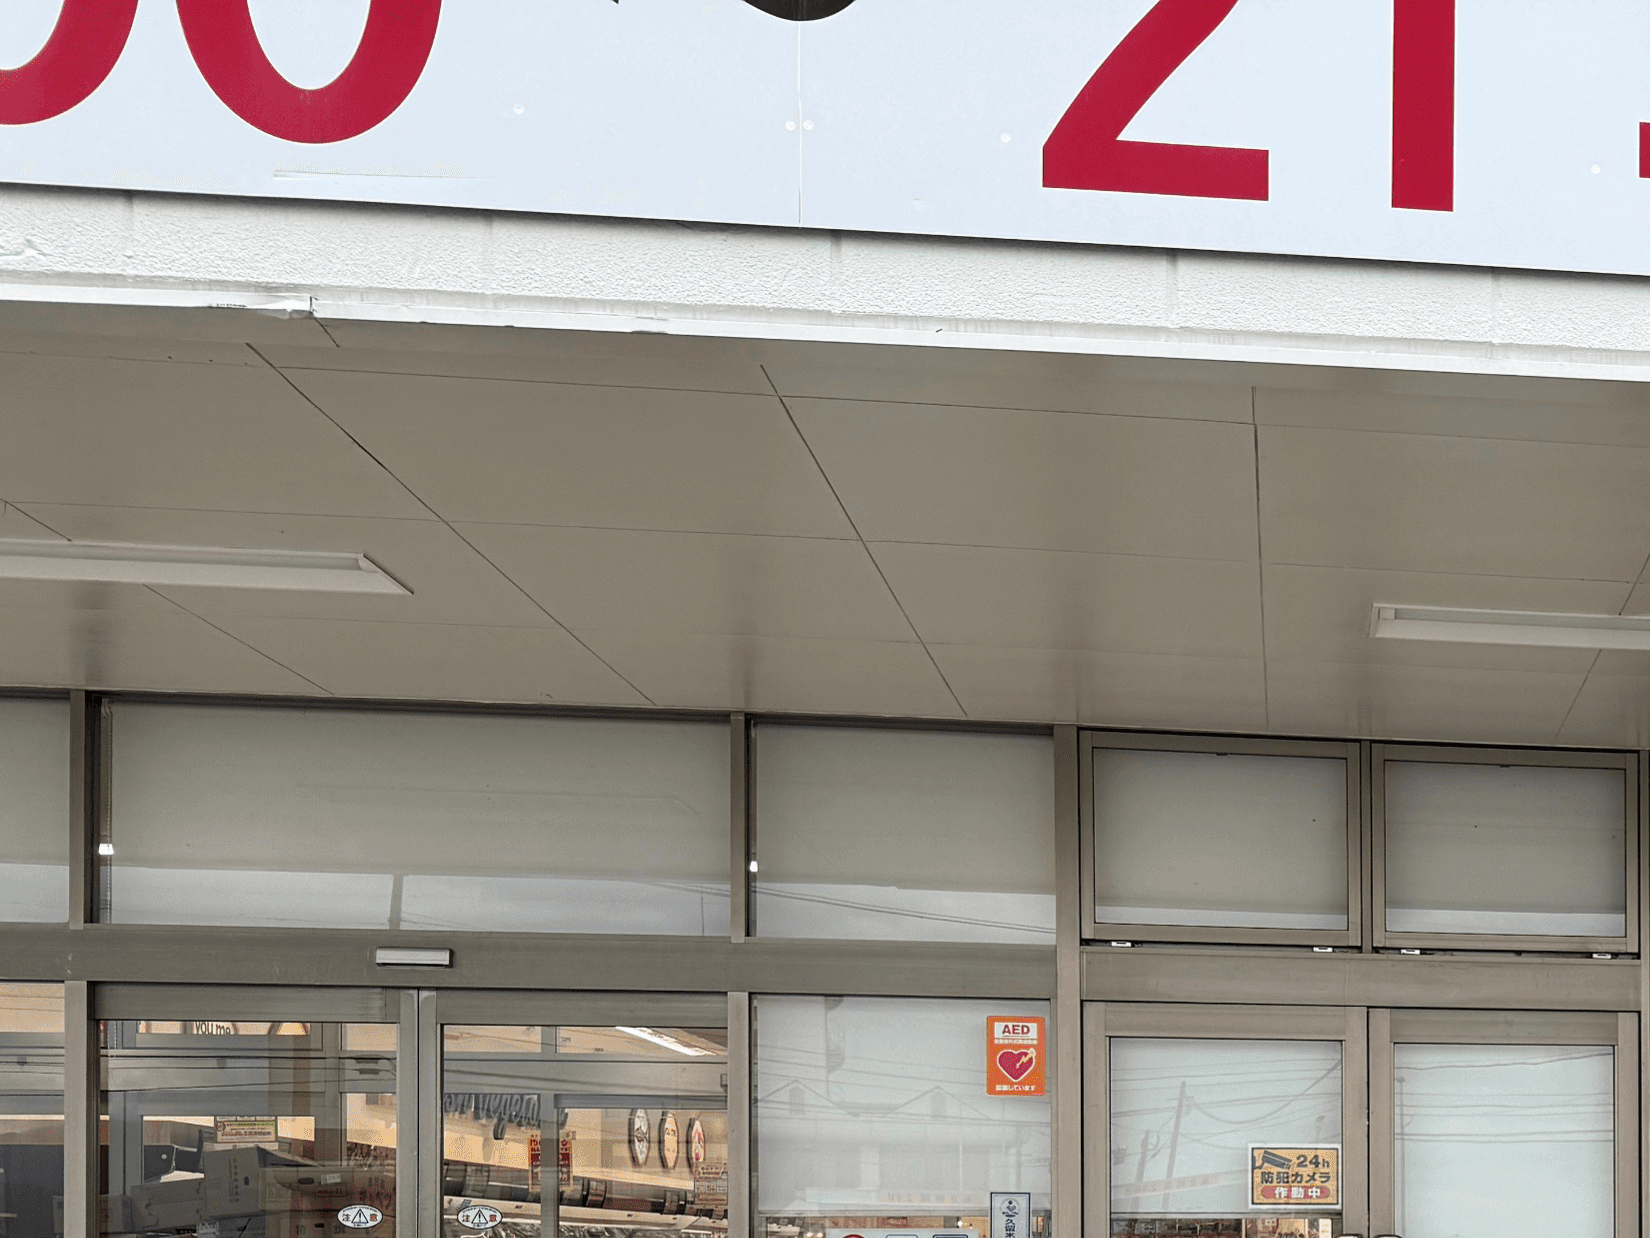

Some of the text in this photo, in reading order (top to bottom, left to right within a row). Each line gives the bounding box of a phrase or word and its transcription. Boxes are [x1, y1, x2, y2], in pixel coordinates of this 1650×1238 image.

[1002, 1024, 1031, 1035] AED
[1296, 1155, 1330, 1168] 24h
[1261, 1172, 1331, 1184] 防犯カメラ
[1275, 1186, 1321, 1198] 作動中
